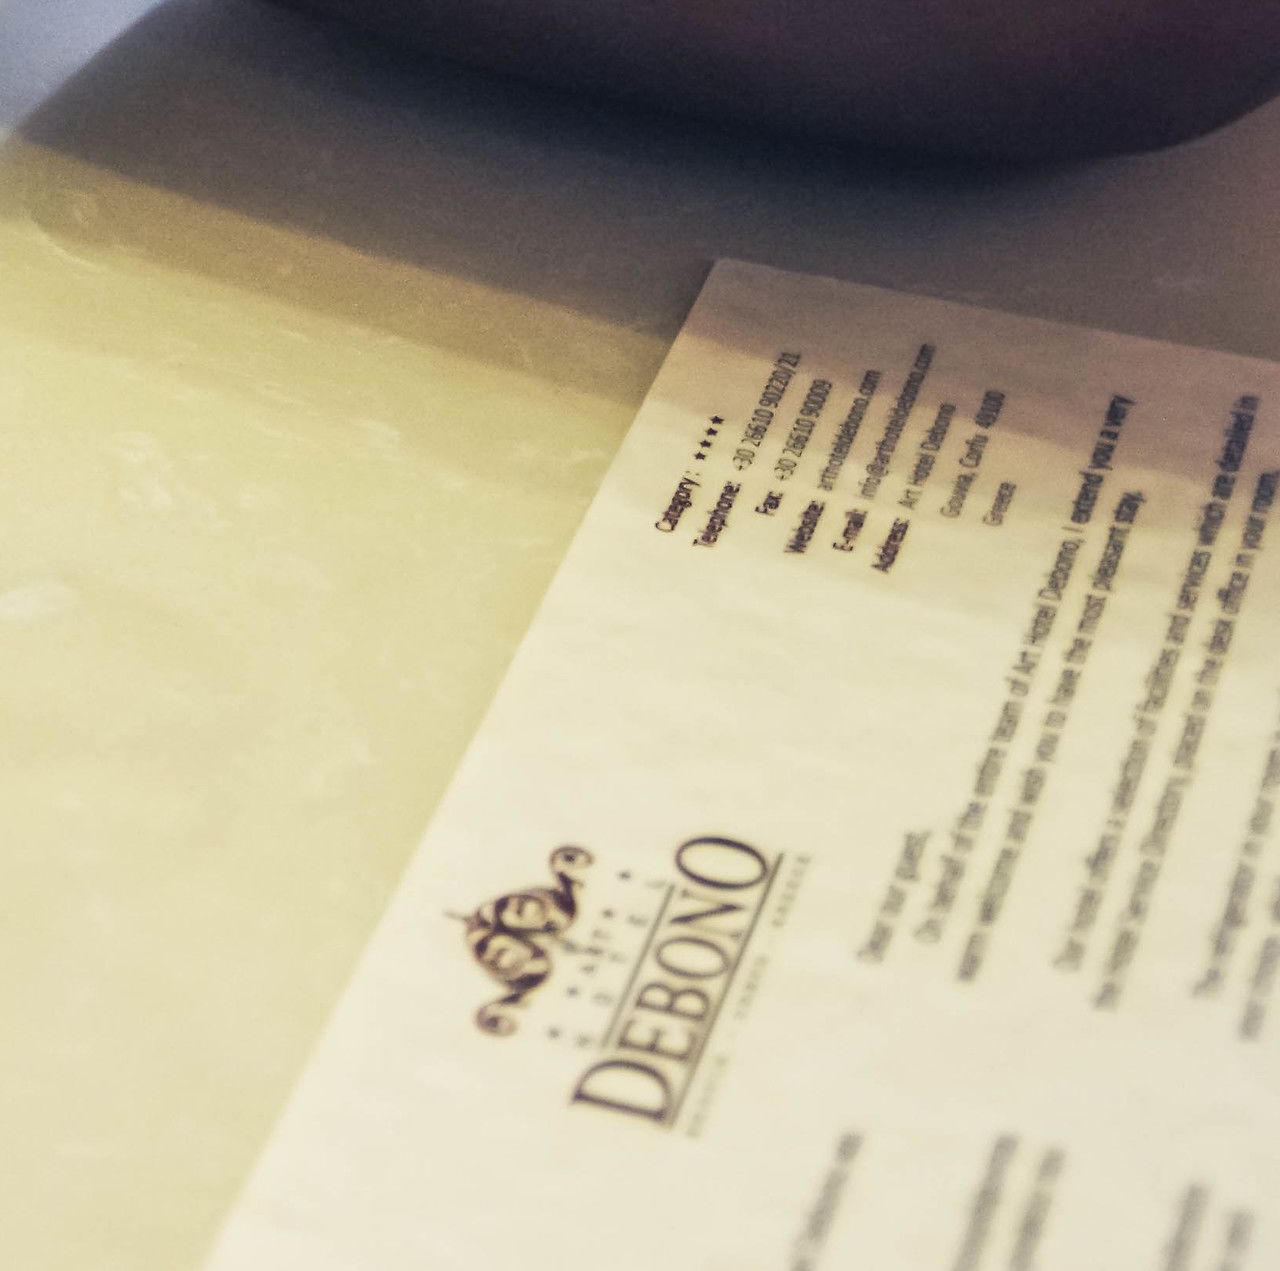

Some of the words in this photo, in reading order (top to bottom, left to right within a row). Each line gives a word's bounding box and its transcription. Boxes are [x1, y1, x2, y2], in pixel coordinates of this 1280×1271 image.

[1098, 427, 1119, 441] a
[1103, 394, 1134, 427] very
[691, 480, 741, 546] Telephone:
[784, 499, 825, 554] Website:
[871, 517, 909, 573] Address:
[571, 834, 770, 1124] DEBONO
